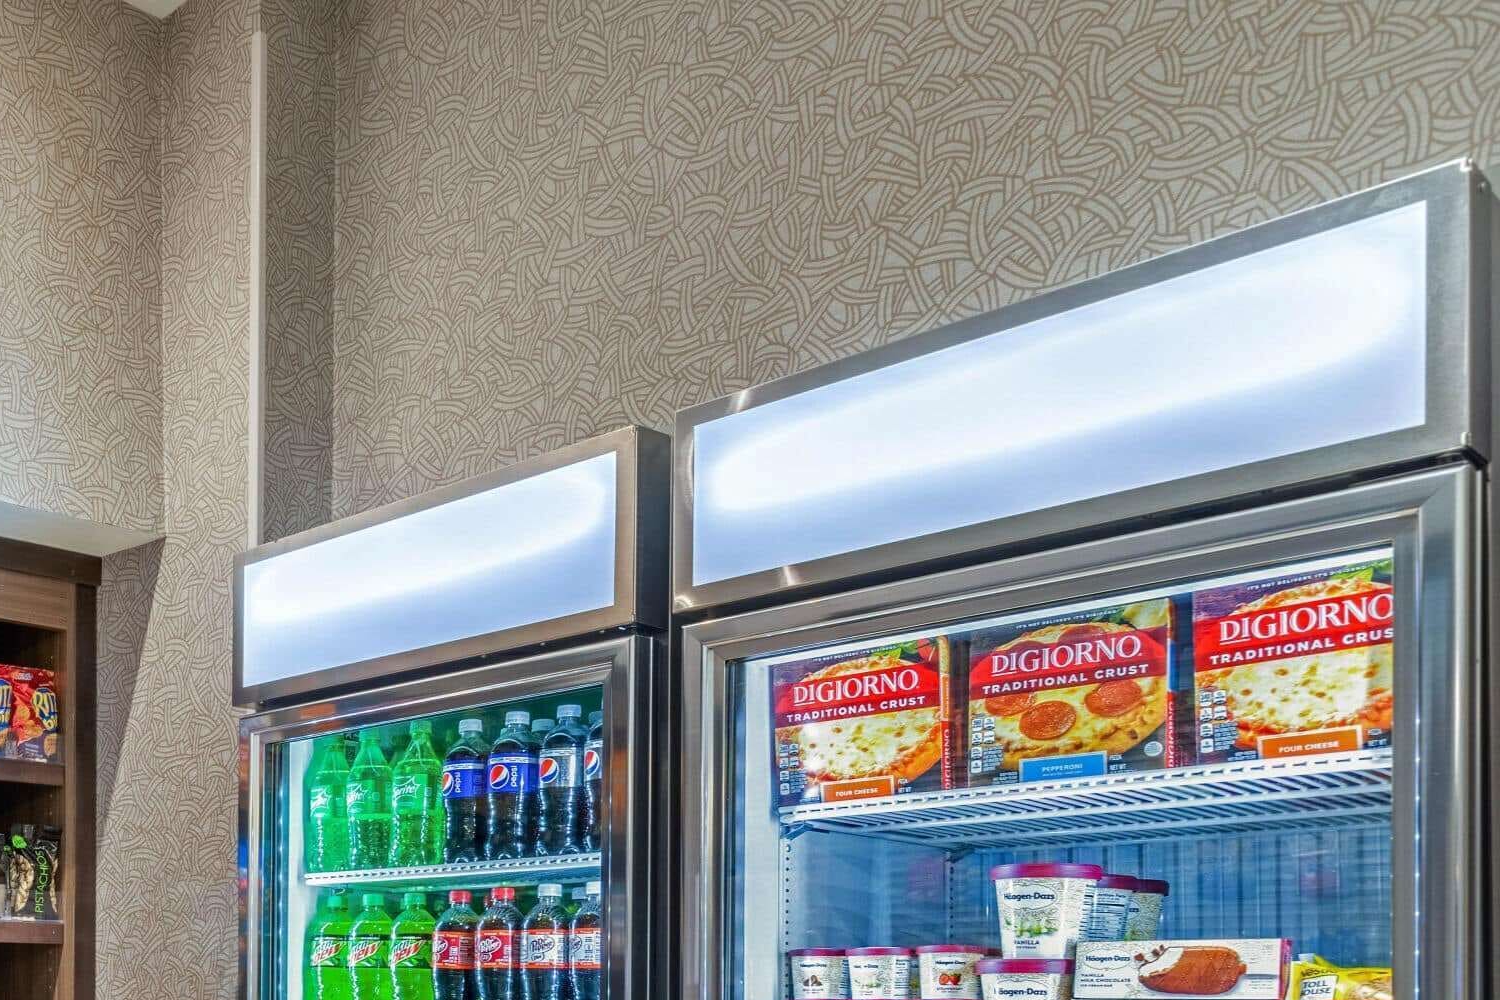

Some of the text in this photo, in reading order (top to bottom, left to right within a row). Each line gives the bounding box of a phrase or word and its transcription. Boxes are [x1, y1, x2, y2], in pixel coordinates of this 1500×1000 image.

[1209, 627, 1394, 666] TRADITIONAL CRUS
[982, 663, 1149, 695] TRADITIONAL CRUST
[786, 696, 926, 723] TRADITIONAL CRUST
[1304, 740, 1340, 751] CHEESE
[510, 765, 518, 787] pepsi
[1041, 763, 1083, 773] PEPPERONI
[34, 849, 49, 913] PISTACHIOS
[1300, 986, 1333, 996] OUSE
[1303, 980, 1328, 990] TOLL
